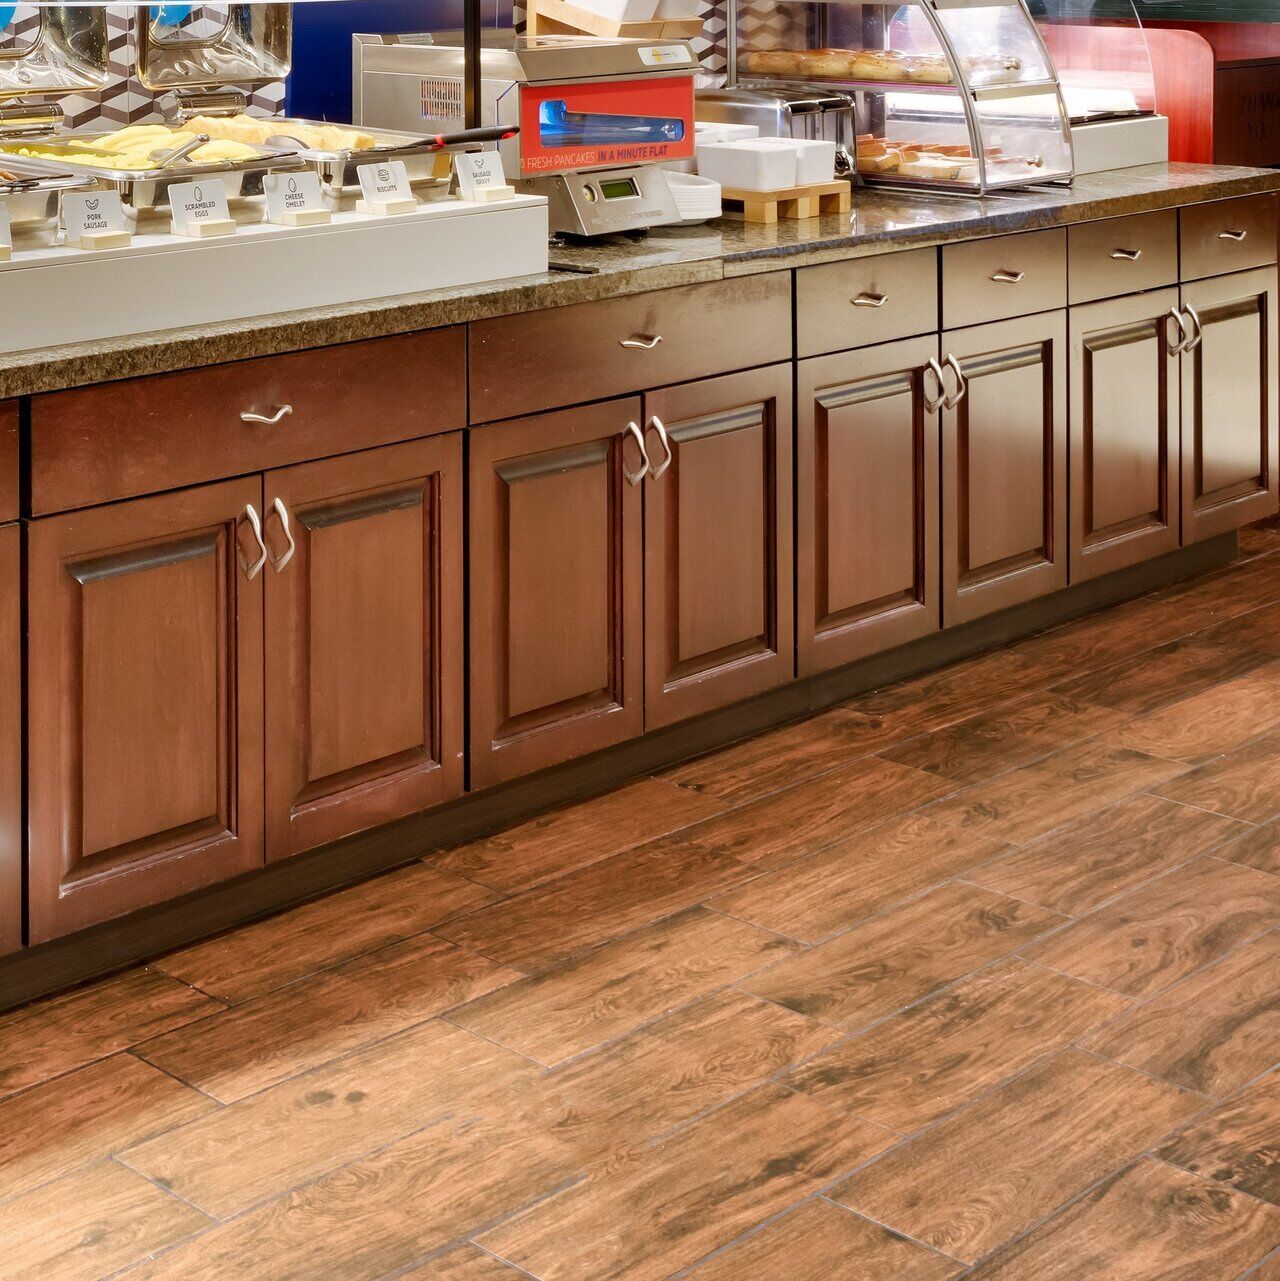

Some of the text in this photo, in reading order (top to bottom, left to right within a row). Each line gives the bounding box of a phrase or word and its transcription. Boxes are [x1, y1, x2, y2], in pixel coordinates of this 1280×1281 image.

[527, 157, 553, 169] FRESH
[554, 151, 595, 166] PANCAKES
[597, 150, 607, 161] IN
[608, 150, 615, 160] A
[616, 147, 647, 160] MINUTE
[649, 145, 669, 157] FLAT
[472, 170, 492, 179] SAUSAGE
[377, 184, 398, 193] BISCUITS
[284, 192, 304, 201] CHEESE
[184, 200, 216, 211] SCRAMBLED
[285, 200, 306, 208] OMELET
[86, 213, 102, 221] PORK
[194, 210, 209, 218] EGGS
[83, 220, 108, 229] SAUSAGE
